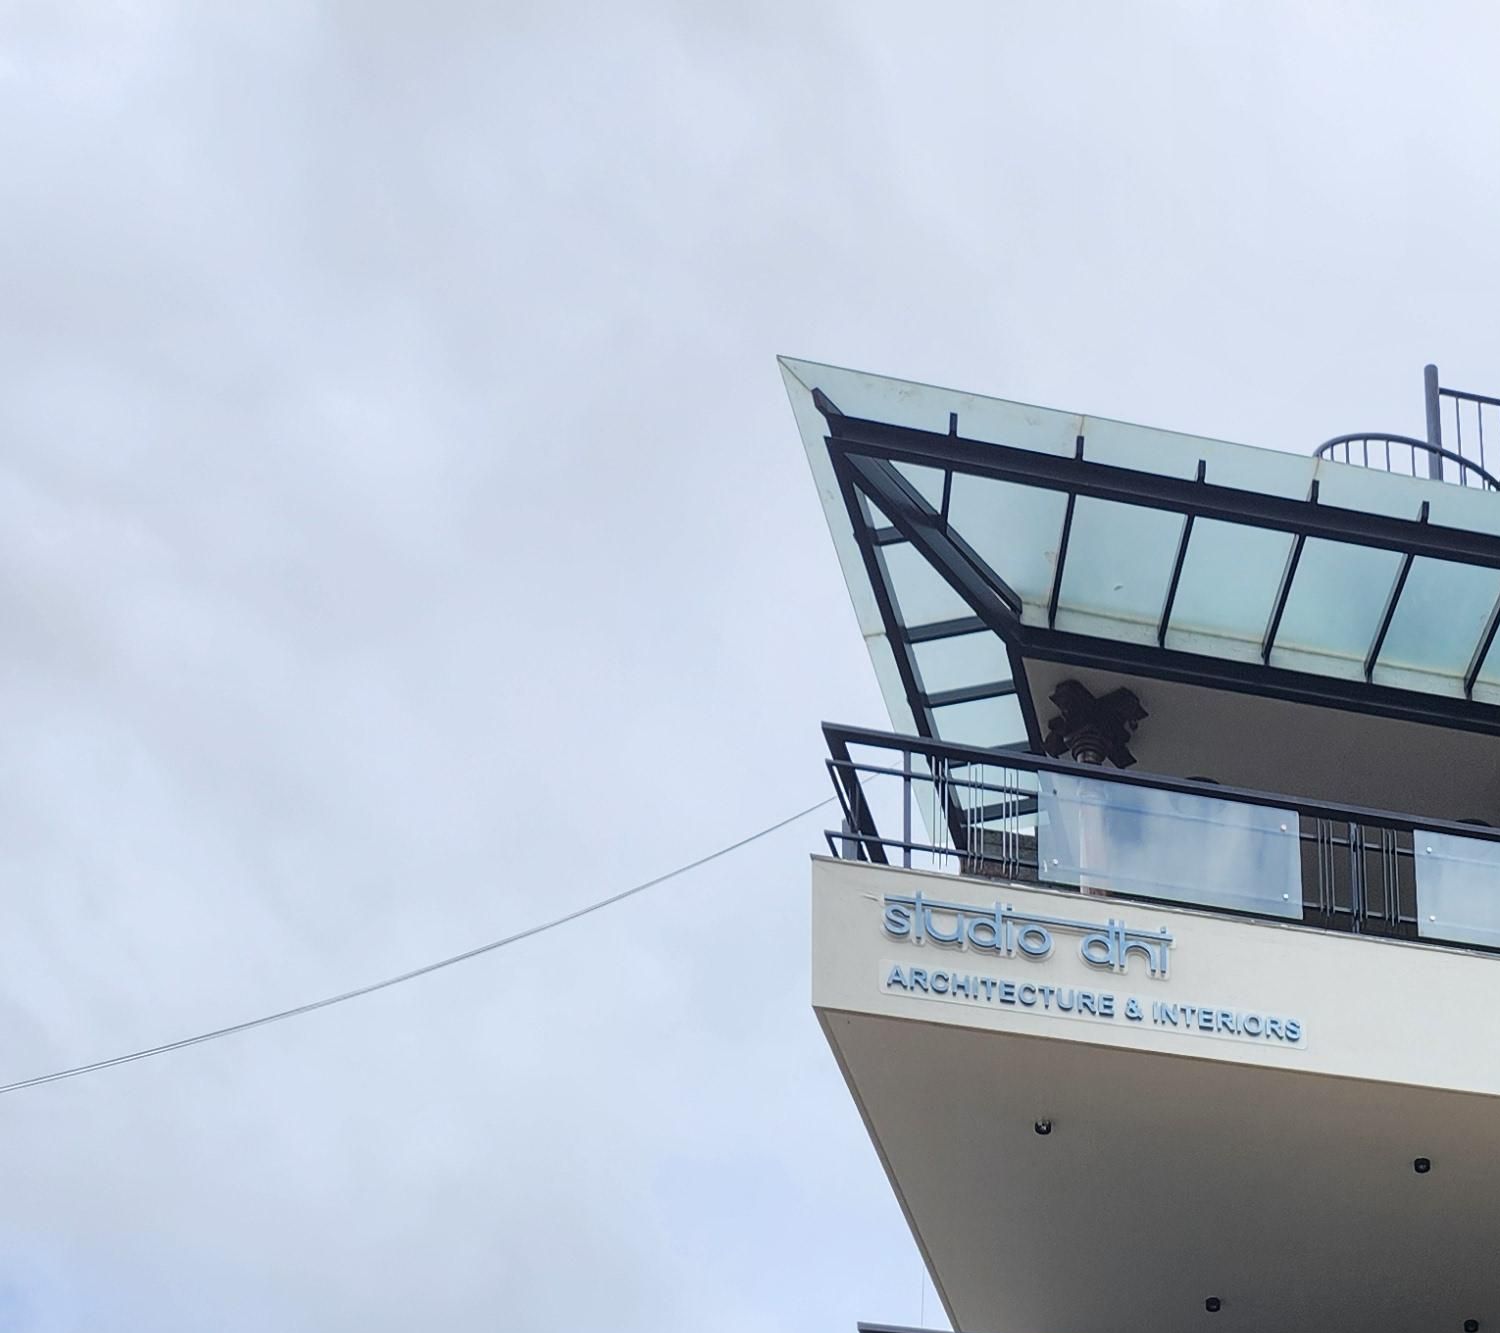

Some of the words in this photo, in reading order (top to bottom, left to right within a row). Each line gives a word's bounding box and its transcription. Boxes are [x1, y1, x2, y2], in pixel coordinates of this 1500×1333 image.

[882, 890, 1054, 957] studio
[887, 965, 1115, 1017] ARCHITECTURE
[1124, 998, 1143, 1020] &
[1152, 1001, 1302, 1042] INTERIORS
